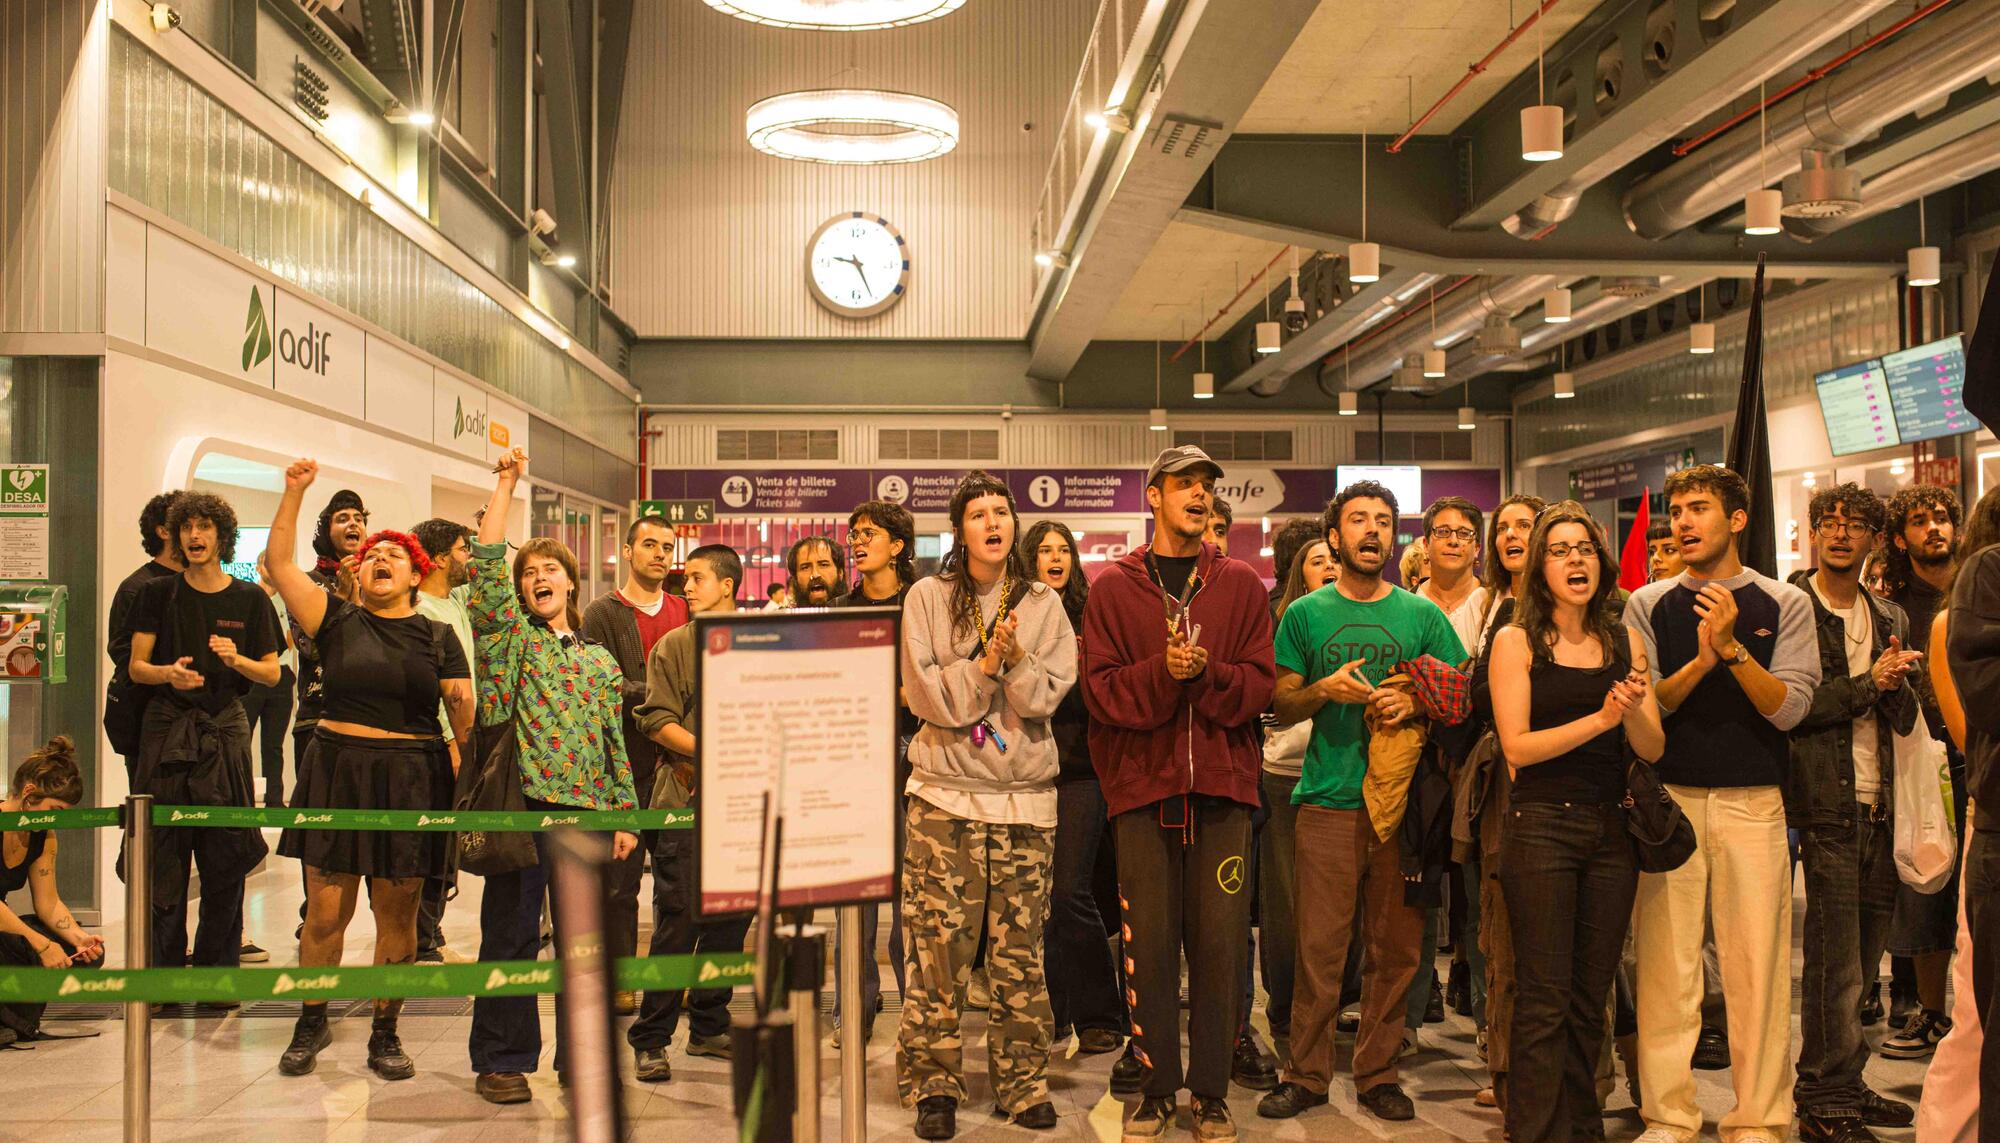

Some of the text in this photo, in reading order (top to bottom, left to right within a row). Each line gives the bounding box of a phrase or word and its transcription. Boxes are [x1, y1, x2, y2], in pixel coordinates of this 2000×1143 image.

[279, 322, 331, 376] adif
[465, 409, 486, 438] adif
[755, 476, 837, 486] Venta de billetes
[913, 476, 955, 486] Atención
[1064, 475, 1122, 486] Información
[756, 488, 828, 497] Venda de billetes
[913, 487, 950, 496] Atención
[1064, 487, 1115, 496] Información
[1213, 479, 1264, 503] enfe
[5, 492, 42, 503] DESA
[1064, 498, 1114, 507] Information
[755, 498, 802, 508] Tickets sale
[1327, 643, 1395, 666] STOP
[31, 815, 57, 824] adif
[184, 811, 211, 820] adif
[307, 814, 334, 822] adif
[431, 816, 457, 824] adif
[554, 816, 580, 824] adif
[677, 813, 695, 822] ad
[508, 968, 553, 985] adif
[83, 976, 128, 992] adif
[296, 974, 341, 990] adif
